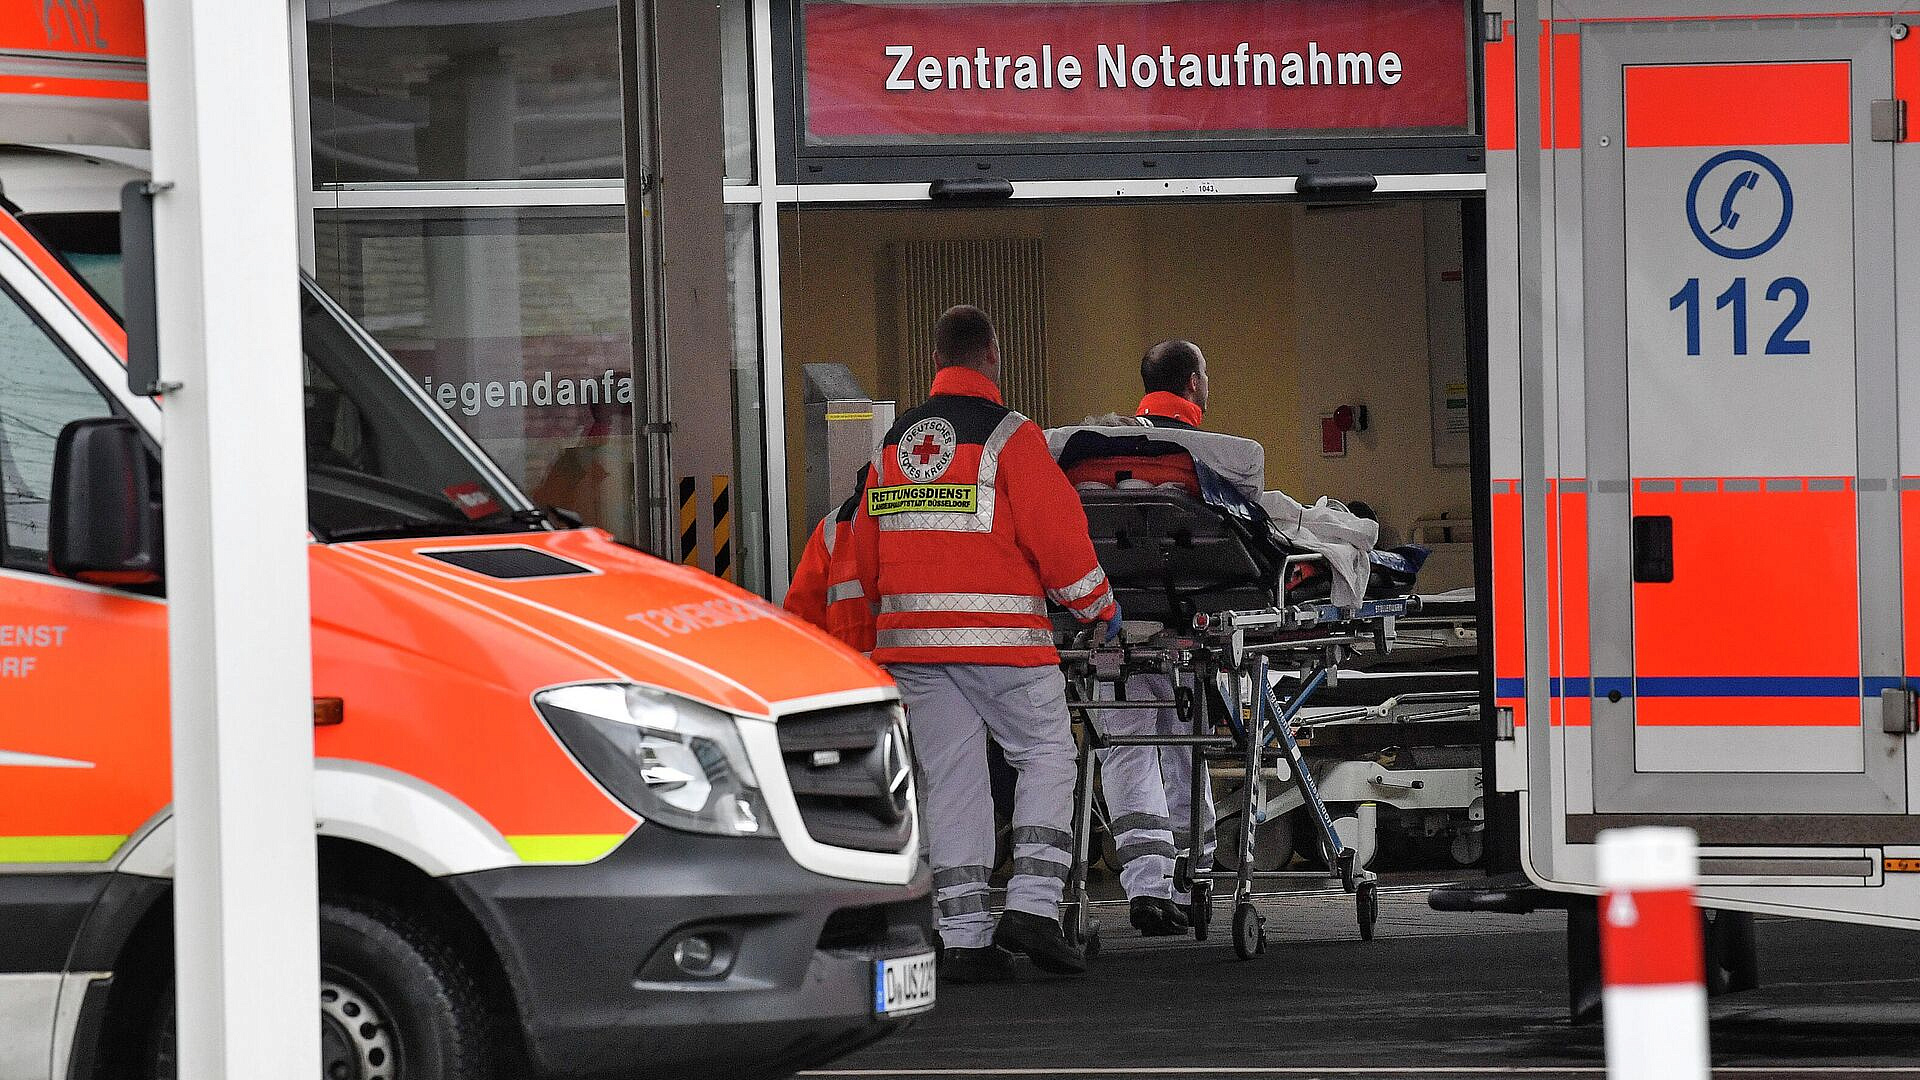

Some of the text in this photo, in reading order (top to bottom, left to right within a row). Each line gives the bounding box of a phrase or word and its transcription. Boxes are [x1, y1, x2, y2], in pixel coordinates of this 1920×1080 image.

[885, 42, 1402, 90] Zentrale Notaufnahme
[1669, 276, 1810, 356] 112
[906, 421, 952, 445] DEUTSCHES
[901, 451, 952, 479] ROTES KREUZ
[872, 488, 971, 503] RETTUNGSDIENST
[927, 499, 971, 508] DÜSSELDORF
